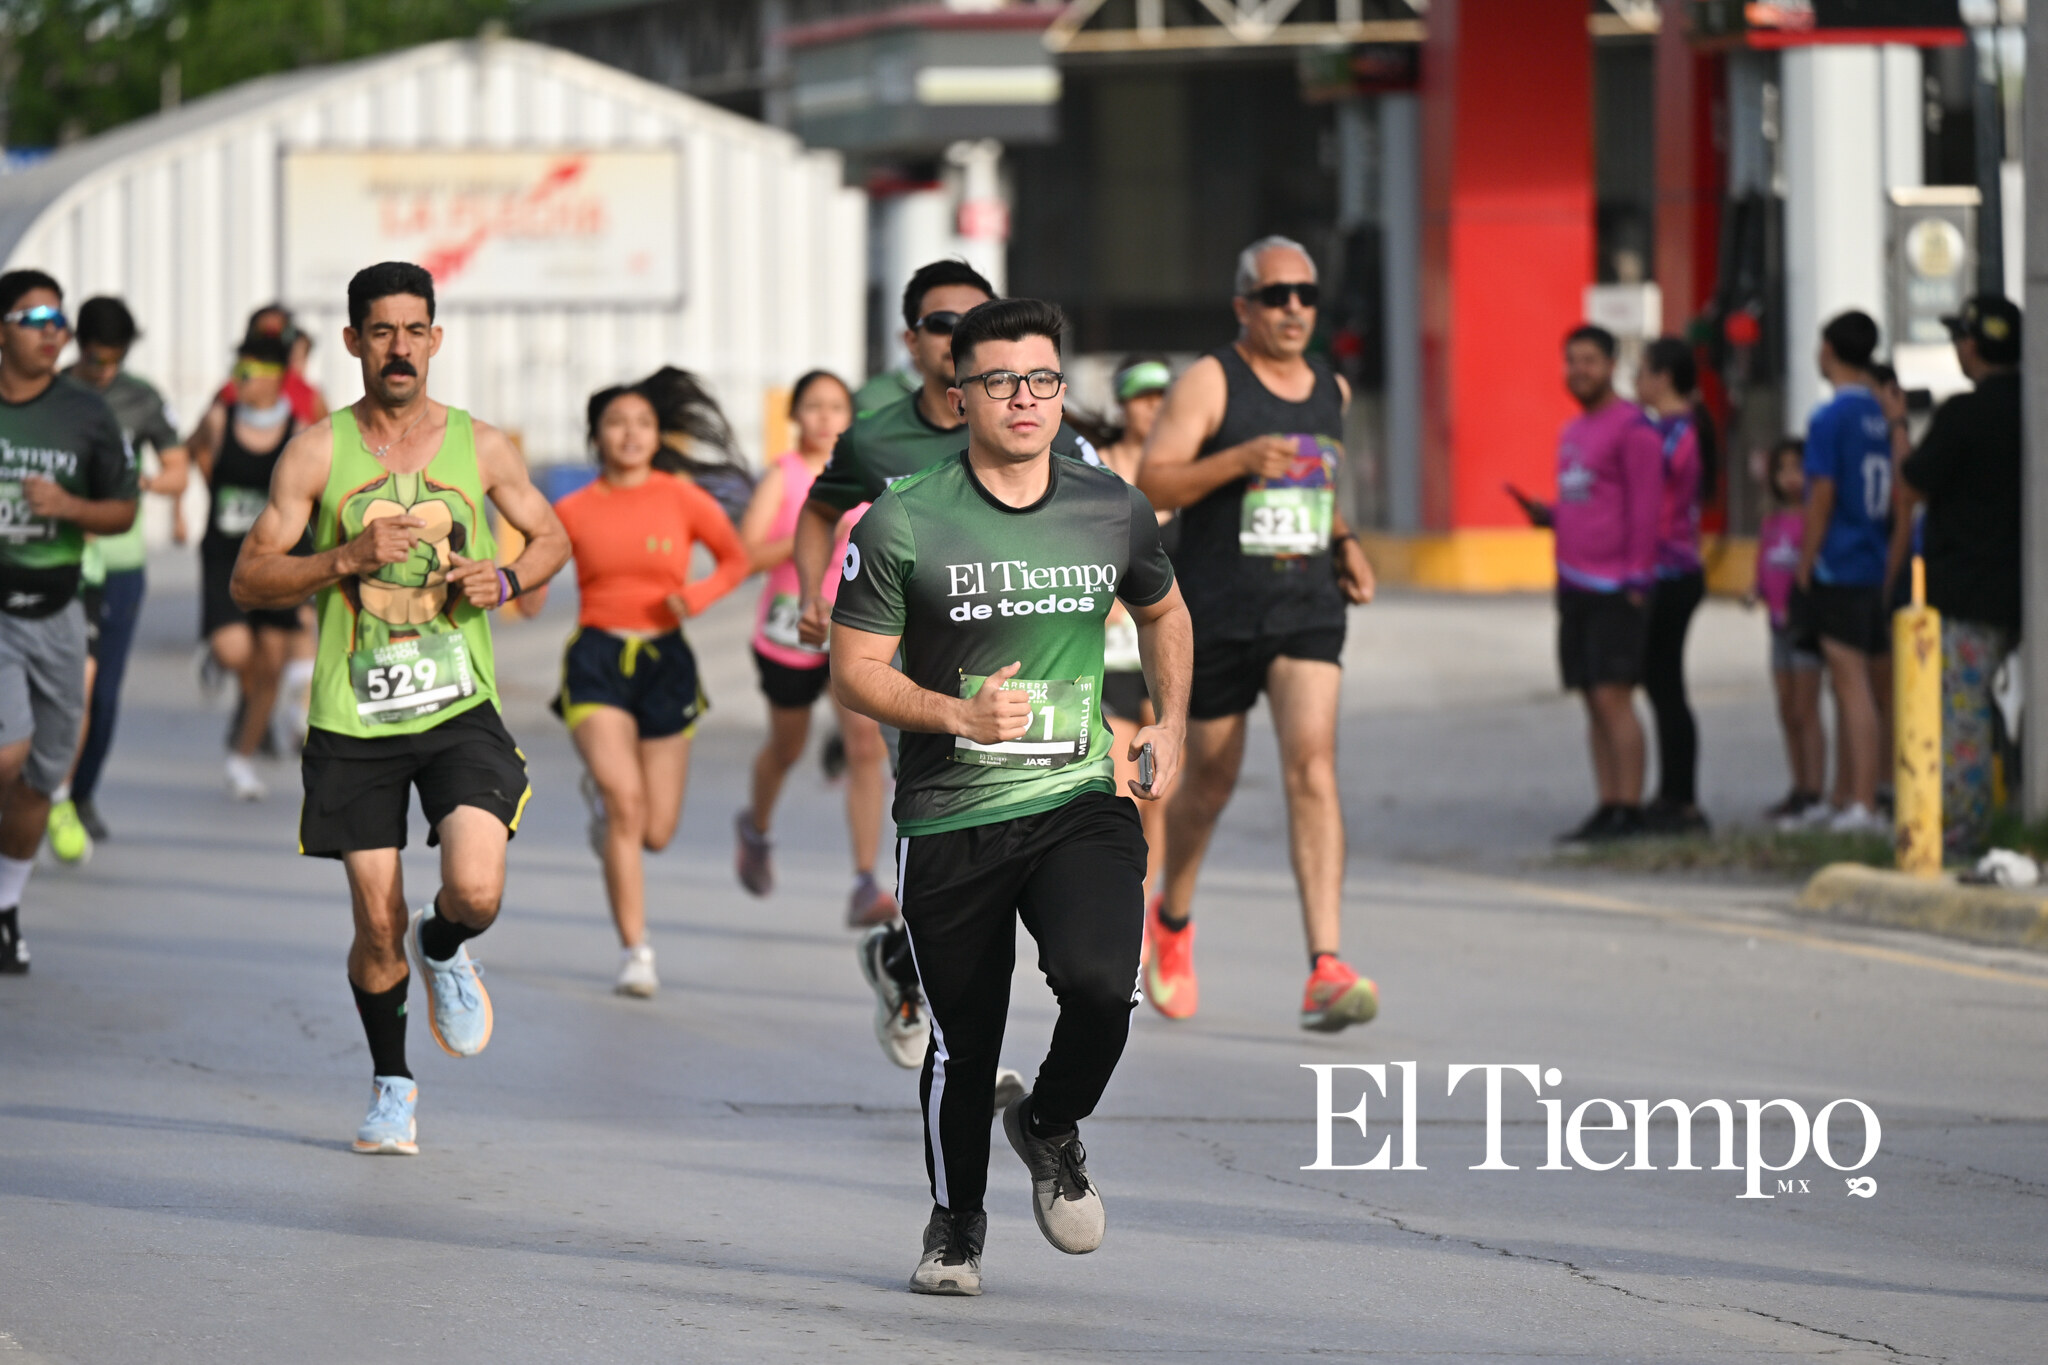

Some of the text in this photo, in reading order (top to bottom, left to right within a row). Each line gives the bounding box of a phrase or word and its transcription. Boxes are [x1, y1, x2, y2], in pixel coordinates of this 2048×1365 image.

[1252, 506, 1311, 534] 321
[946, 560, 1117, 597] El Tiempo
[950, 594, 1095, 622] de todos
[368, 657, 437, 700] 529
[1001, 680, 1049, 690] ARRERA
[1080, 682, 1092, 692] 191
[1078, 696, 1091, 756] MEDALLA
